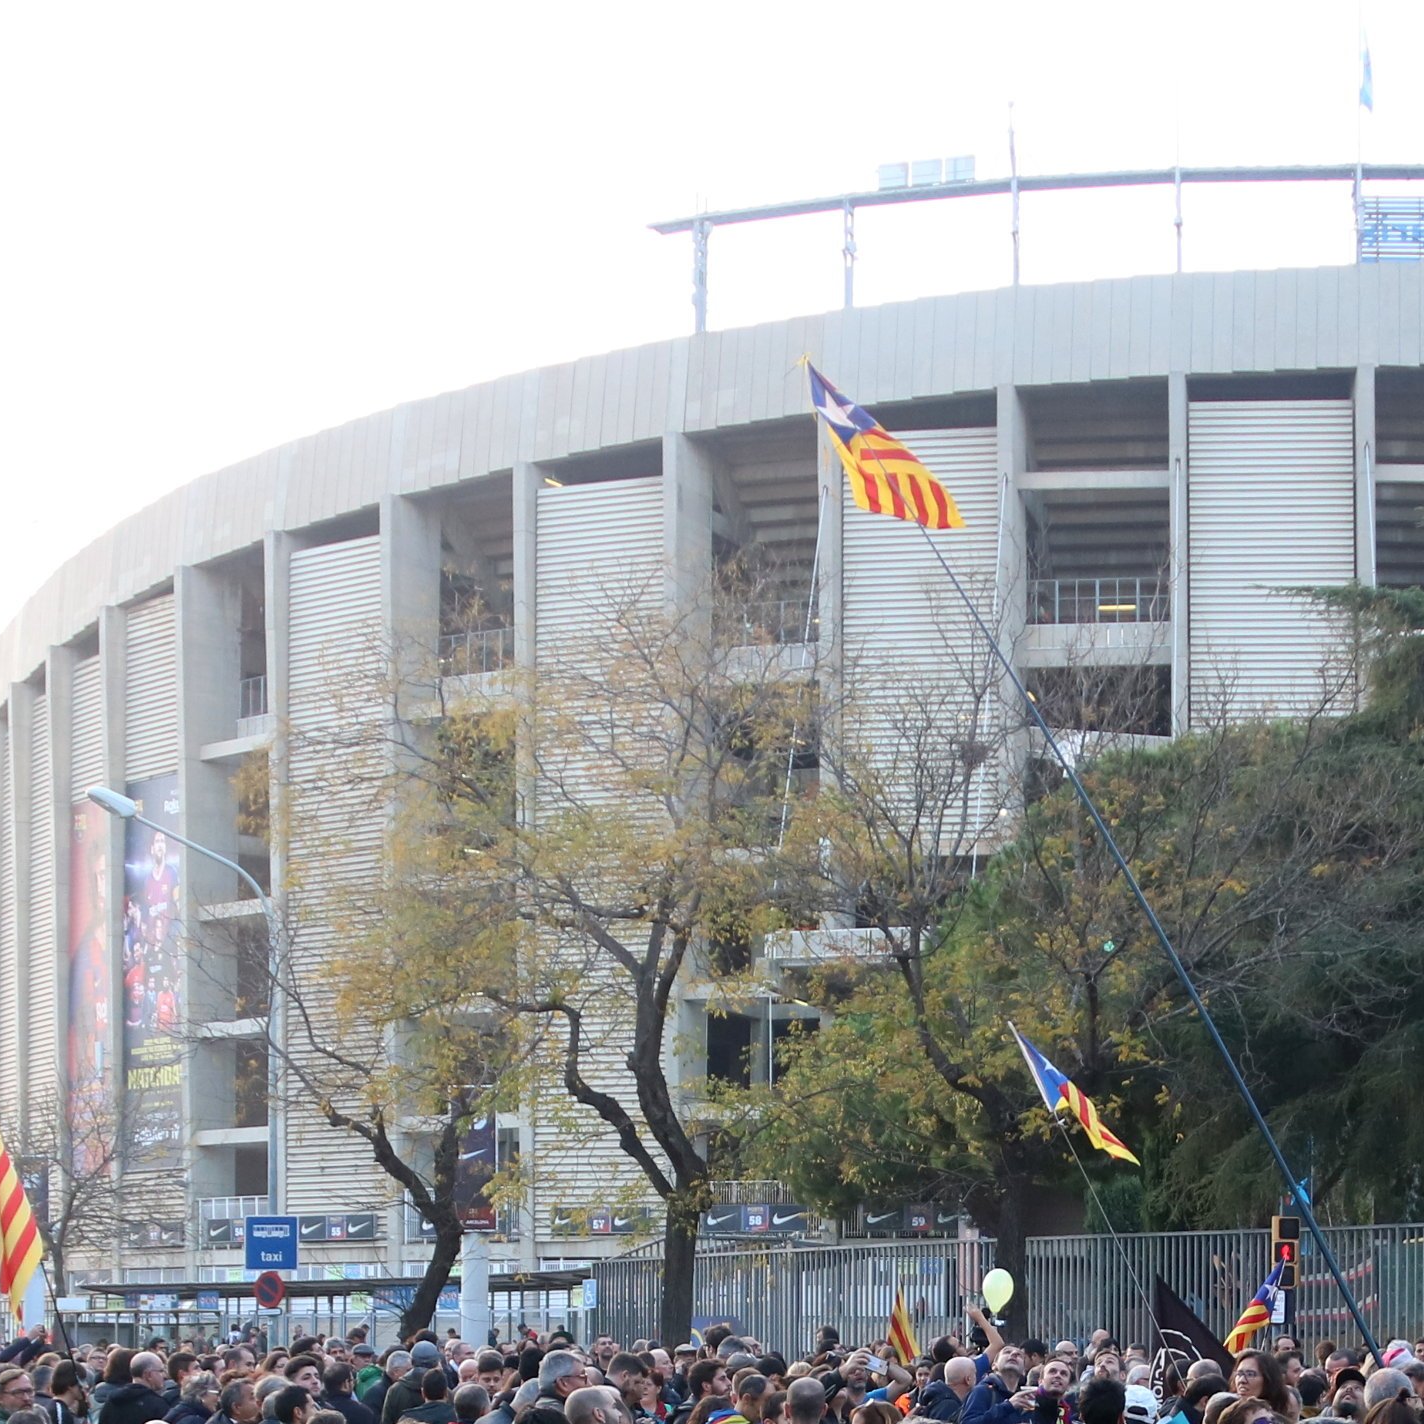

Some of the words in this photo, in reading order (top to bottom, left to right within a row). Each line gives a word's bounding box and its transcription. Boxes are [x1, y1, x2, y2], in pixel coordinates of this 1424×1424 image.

[748, 1215, 762, 1226] 58
[911, 1216, 926, 1227] 59
[331, 1227, 341, 1237] 55
[260, 1251, 283, 1262] taxi
